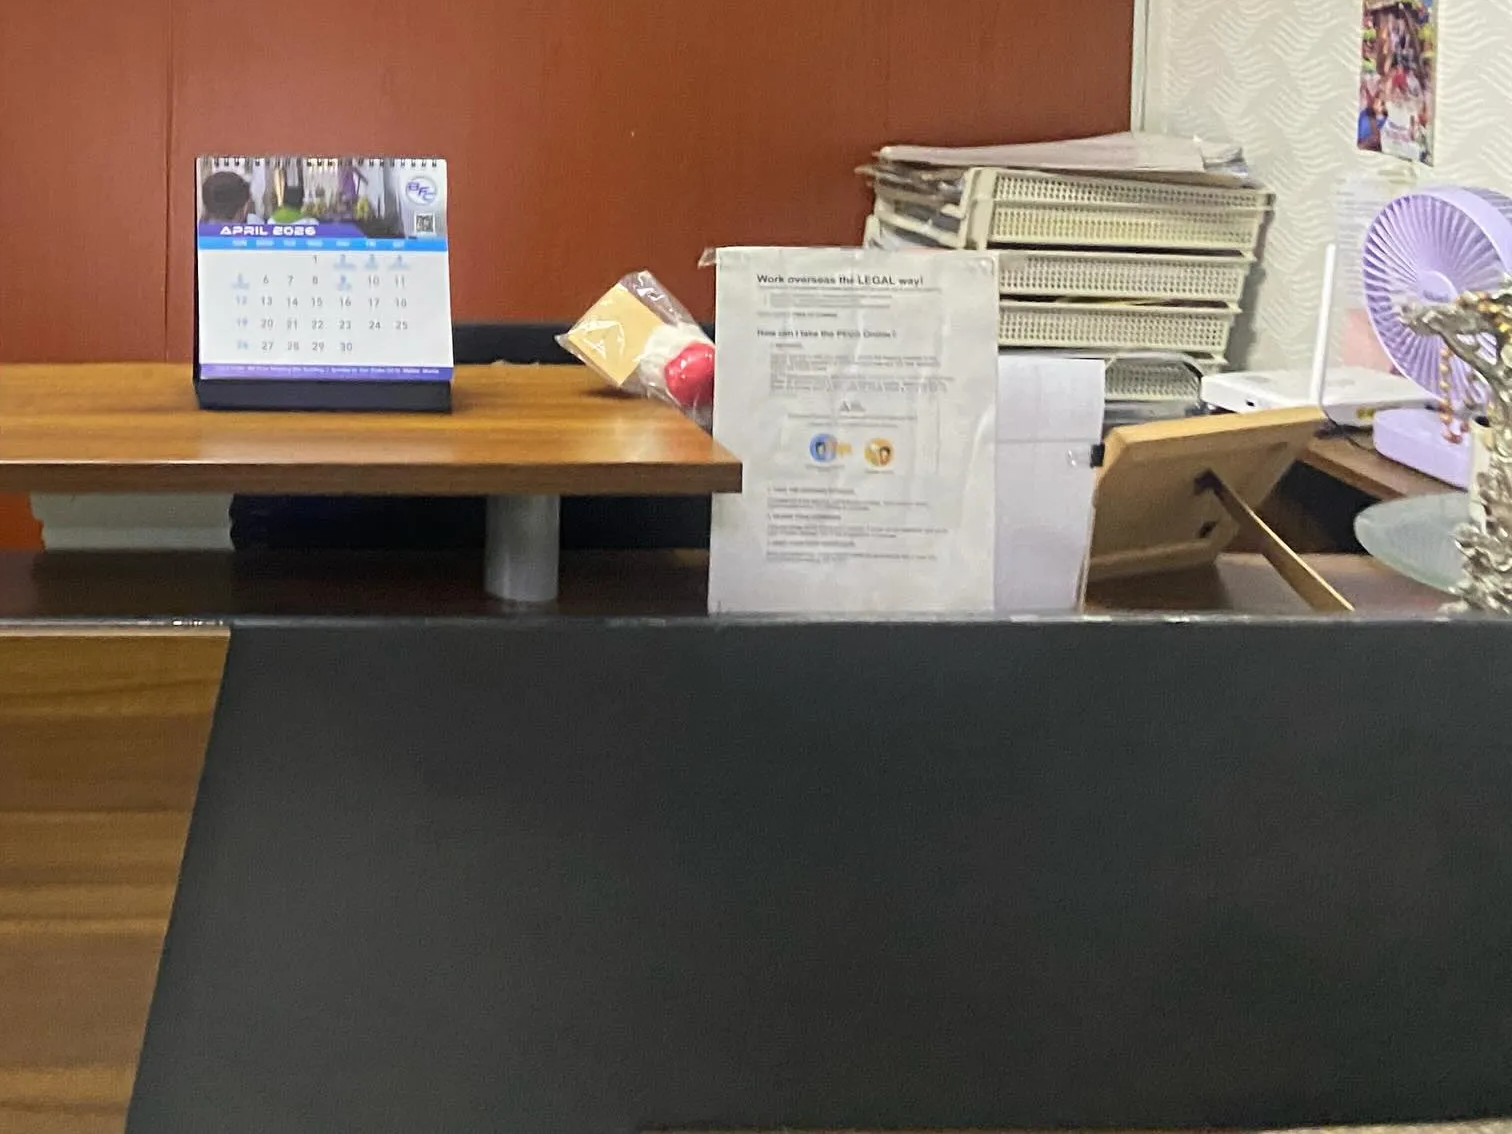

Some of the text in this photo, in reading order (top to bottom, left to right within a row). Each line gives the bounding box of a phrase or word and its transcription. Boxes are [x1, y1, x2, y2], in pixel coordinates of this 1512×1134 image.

[220, 225, 317, 237] APRIL 2026
[263, 275, 269, 284] 6
[288, 275, 293, 285] 7
[368, 275, 379, 286] 10
[395, 275, 405, 288] 11
[756, 274, 785, 284] Work
[787, 275, 836, 285] overseas
[839, 274, 854, 285] the
[857, 275, 896, 286] LEGAL
[262, 296, 272, 306] 13
[288, 298, 298, 307] 14
[312, 297, 323, 307] 15
[340, 297, 351, 307] 16
[368, 298, 379, 308] 17
[261, 319, 273, 328] 20
[312, 320, 323, 330] 22
[340, 320, 351, 329] 23
[369, 321, 380, 330] 24
[396, 321, 408, 330] 25
[262, 342, 273, 350] 27
[288, 341, 299, 351] 28
[312, 342, 324, 351] 29
